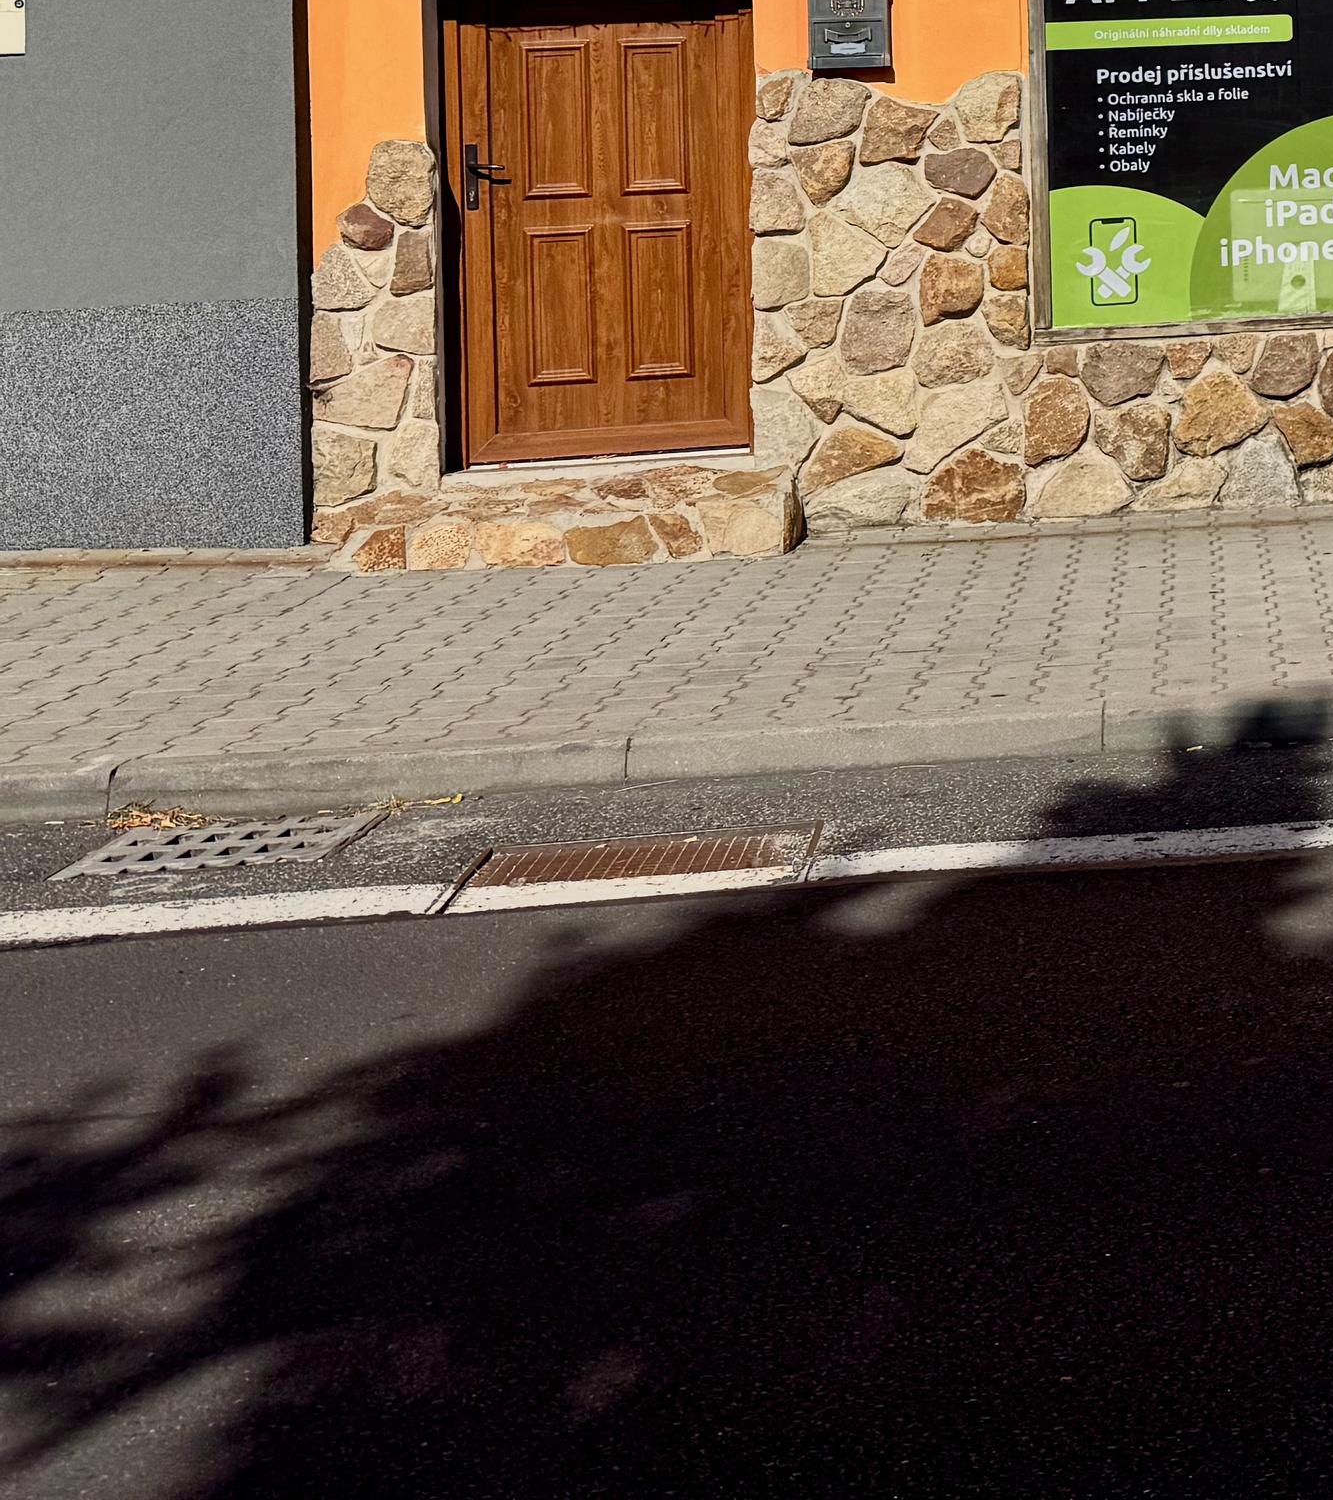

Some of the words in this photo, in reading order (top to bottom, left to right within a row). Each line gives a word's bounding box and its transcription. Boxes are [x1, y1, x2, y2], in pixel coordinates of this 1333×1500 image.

[1225, 25, 1271, 36] skladem
[1096, 65, 1162, 86] Prodej
[1167, 60, 1293, 85] příslušenství
[1107, 90, 1174, 106] Ochranná
[1176, 89, 1204, 103] skla
[1206, 92, 1215, 101] a
[1218, 87, 1249, 101] folie
[1108, 107, 1176, 123] Nabíječky
[1108, 124, 1168, 139] Řemínky
[1109, 141, 1157, 156] Kabely
[1109, 158, 1151, 173] Obaly
